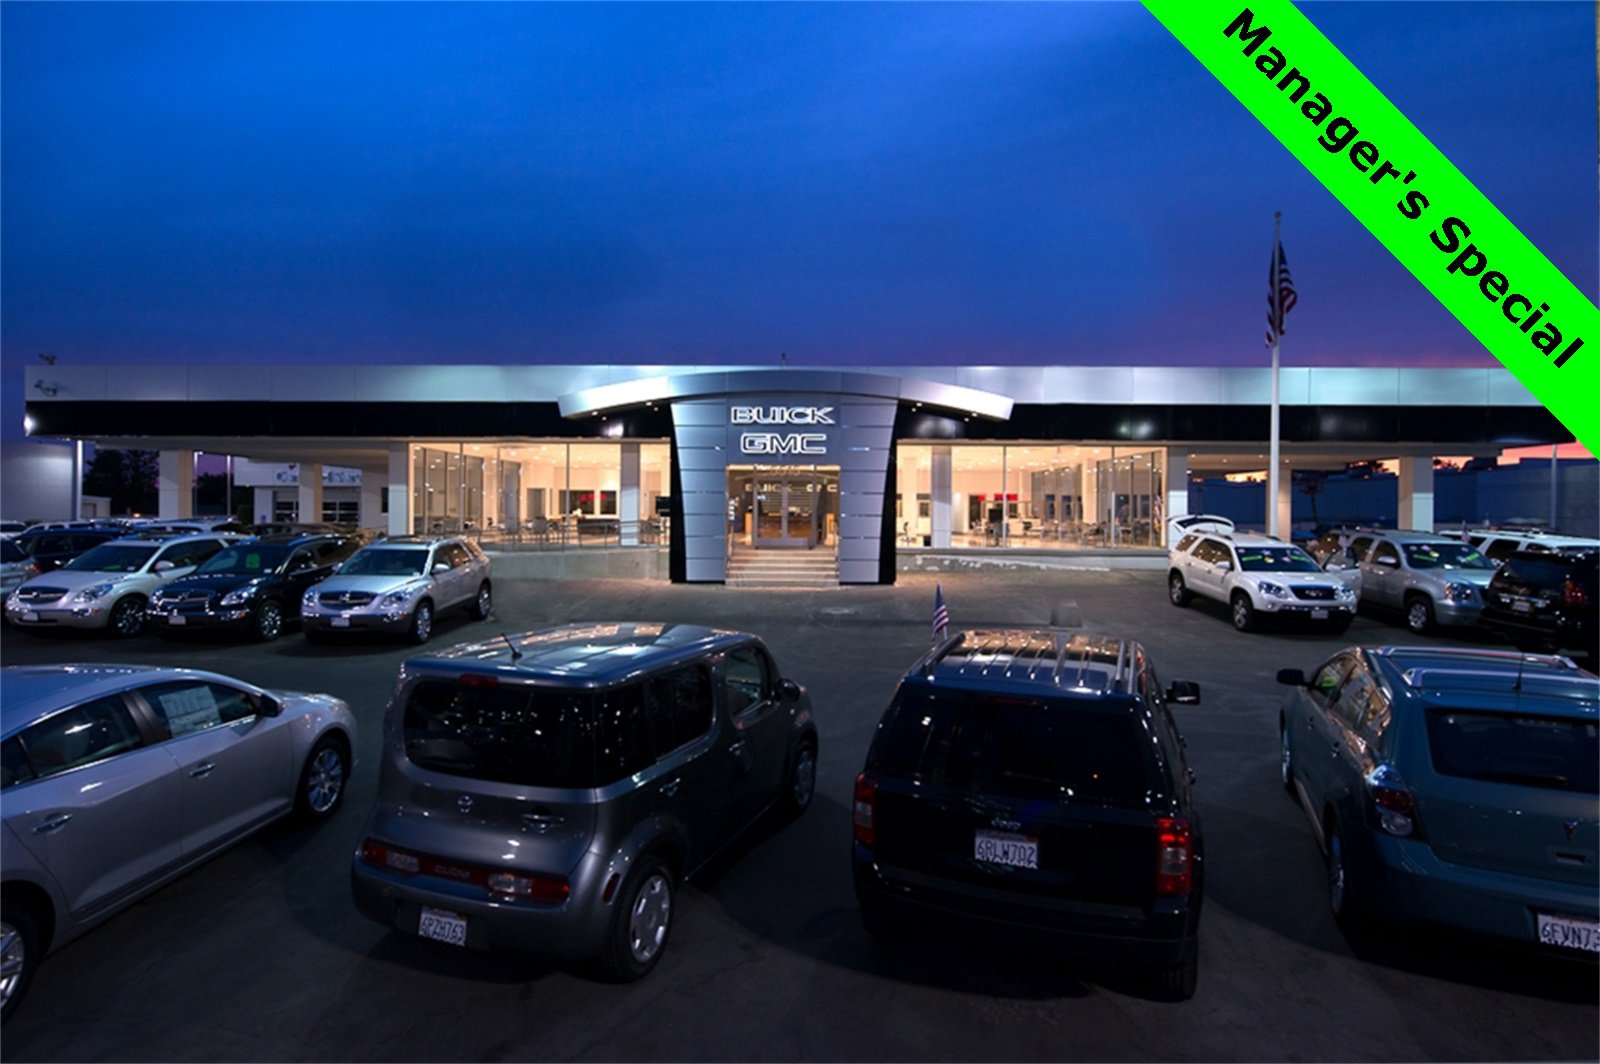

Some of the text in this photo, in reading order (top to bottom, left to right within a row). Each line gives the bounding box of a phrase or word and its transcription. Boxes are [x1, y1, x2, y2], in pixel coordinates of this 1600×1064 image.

[731, 406, 836, 425] BUICK
[740, 432, 827, 454] GMC
[977, 839, 1035, 865] 6RLW702
